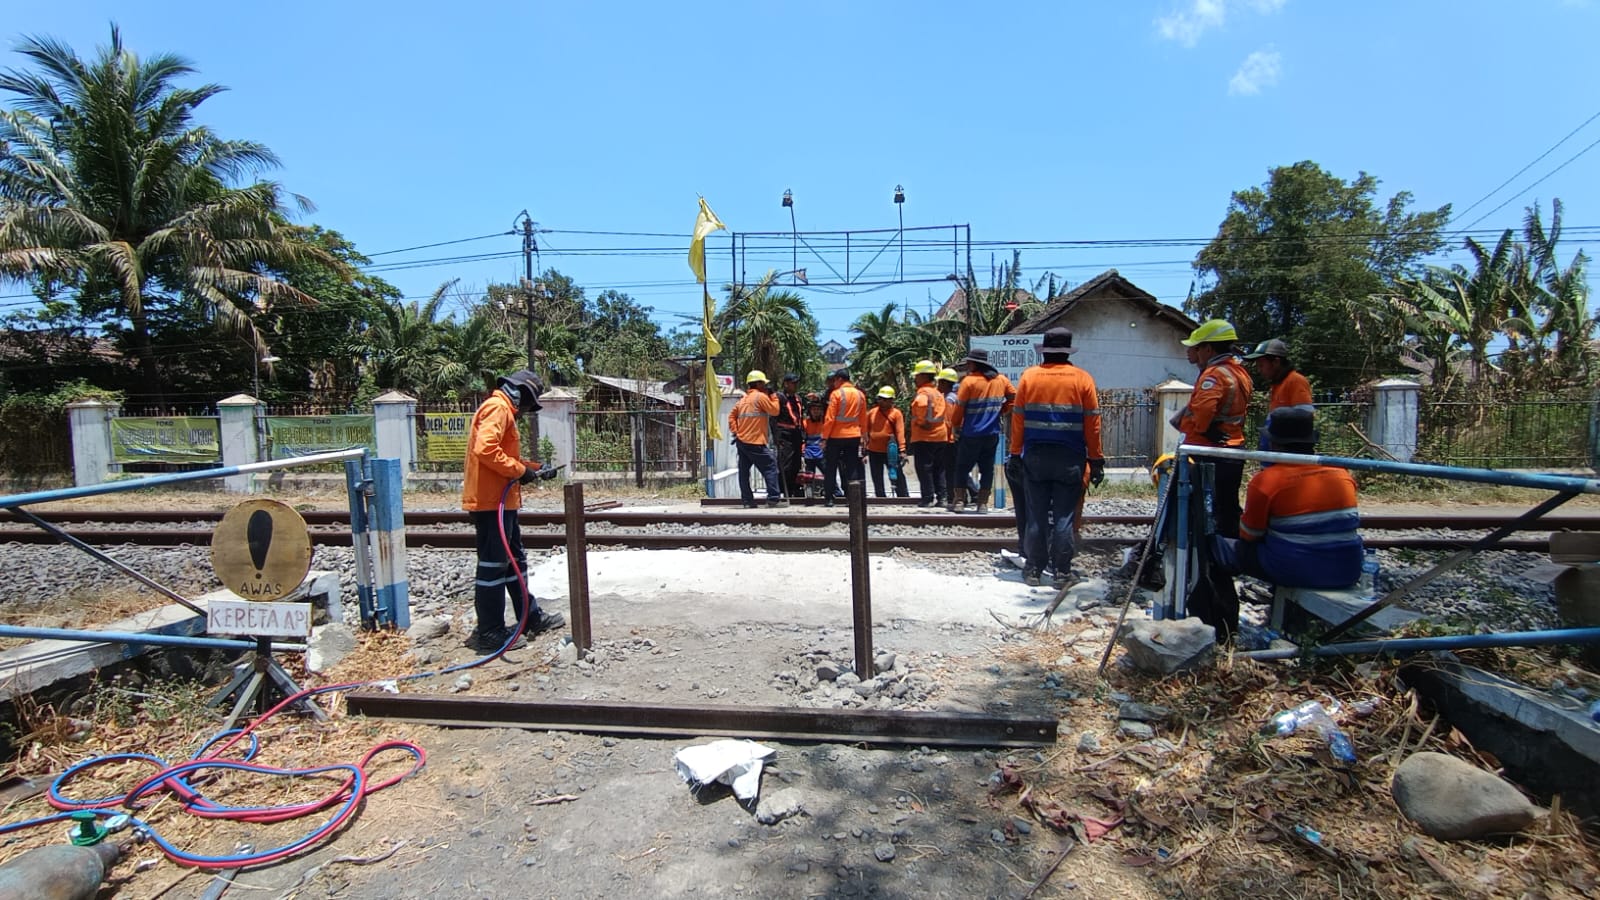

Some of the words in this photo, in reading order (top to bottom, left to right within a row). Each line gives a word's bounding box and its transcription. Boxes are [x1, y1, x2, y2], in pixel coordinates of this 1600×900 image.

[1003, 338, 1029, 346] TOKO
[240, 582, 282, 595] AWAS
[209, 607, 279, 630] KERETA
[283, 610, 309, 631] API
